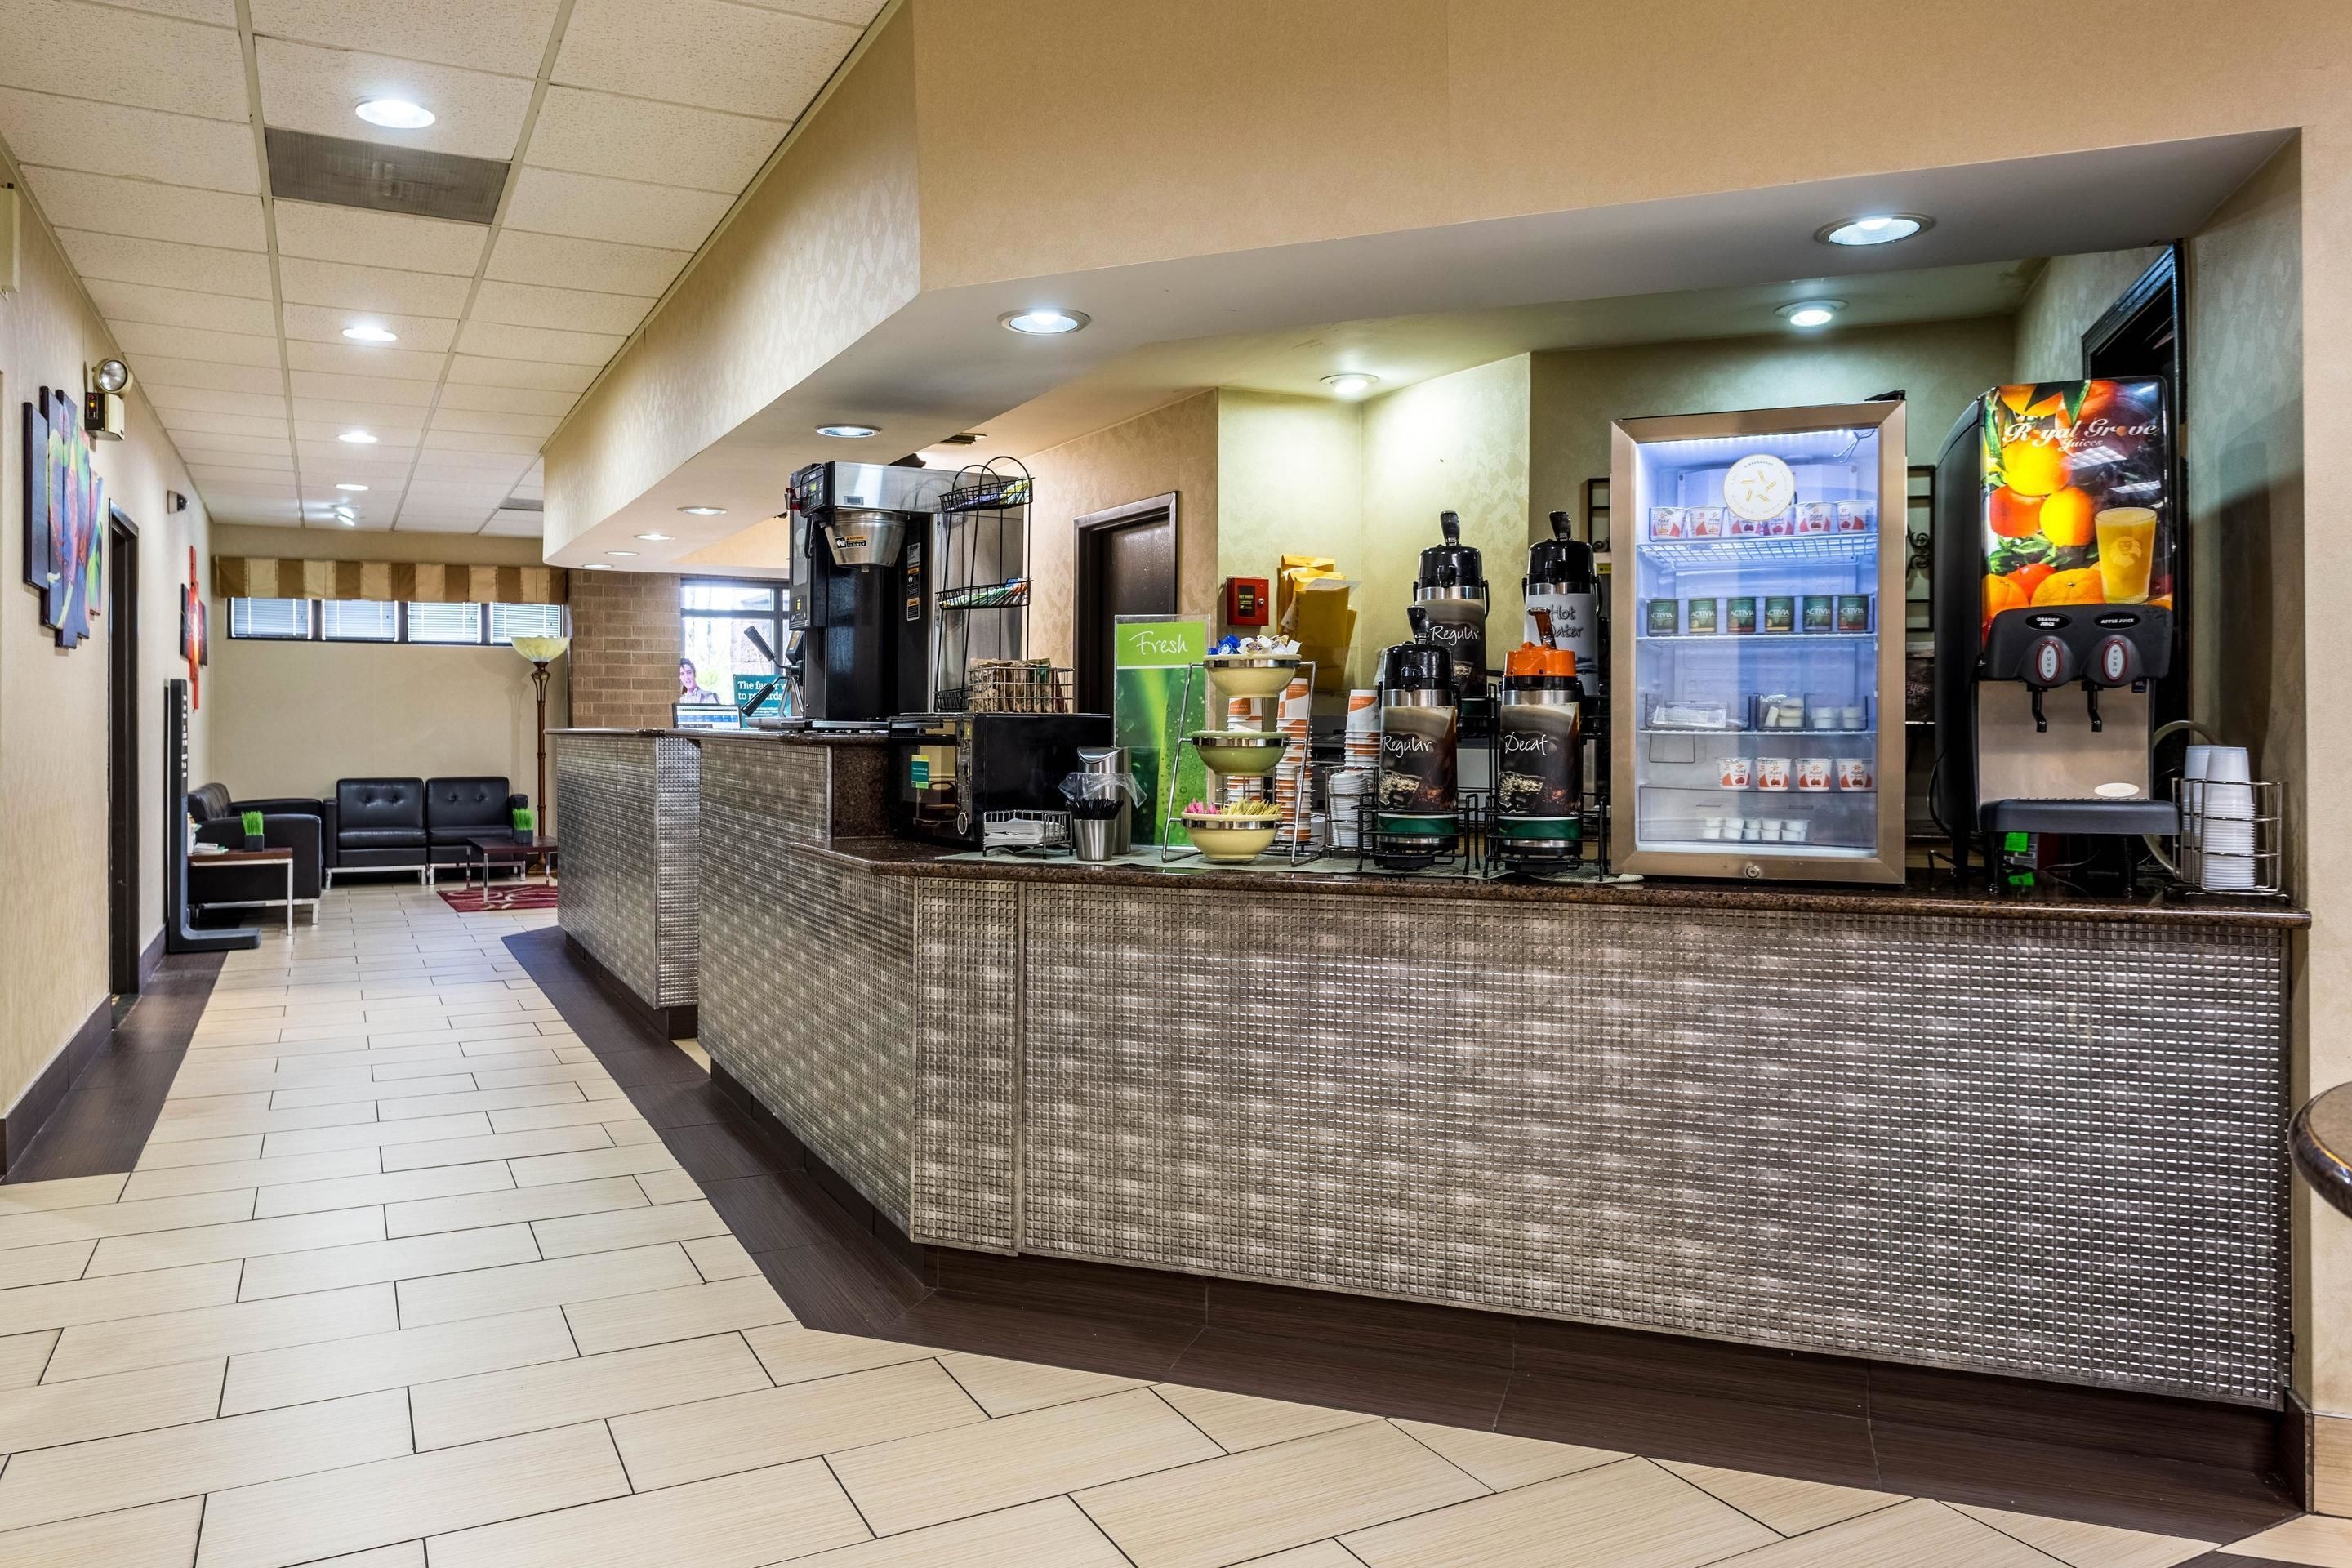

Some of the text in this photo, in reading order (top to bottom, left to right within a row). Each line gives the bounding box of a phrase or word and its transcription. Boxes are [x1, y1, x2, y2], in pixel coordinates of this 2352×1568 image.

[2002, 418, 2159, 448] Royal Grove
[2058, 437, 2104, 451] Juices
[1551, 604, 1576, 621] Hot
[1130, 630, 1188, 655] Fresh
[1430, 626, 1480, 645] Regular
[737, 680, 755, 690] The
[738, 692, 747, 700] to
[1381, 736, 1432, 758] Regular
[1505, 732, 1548, 756] Decaf
